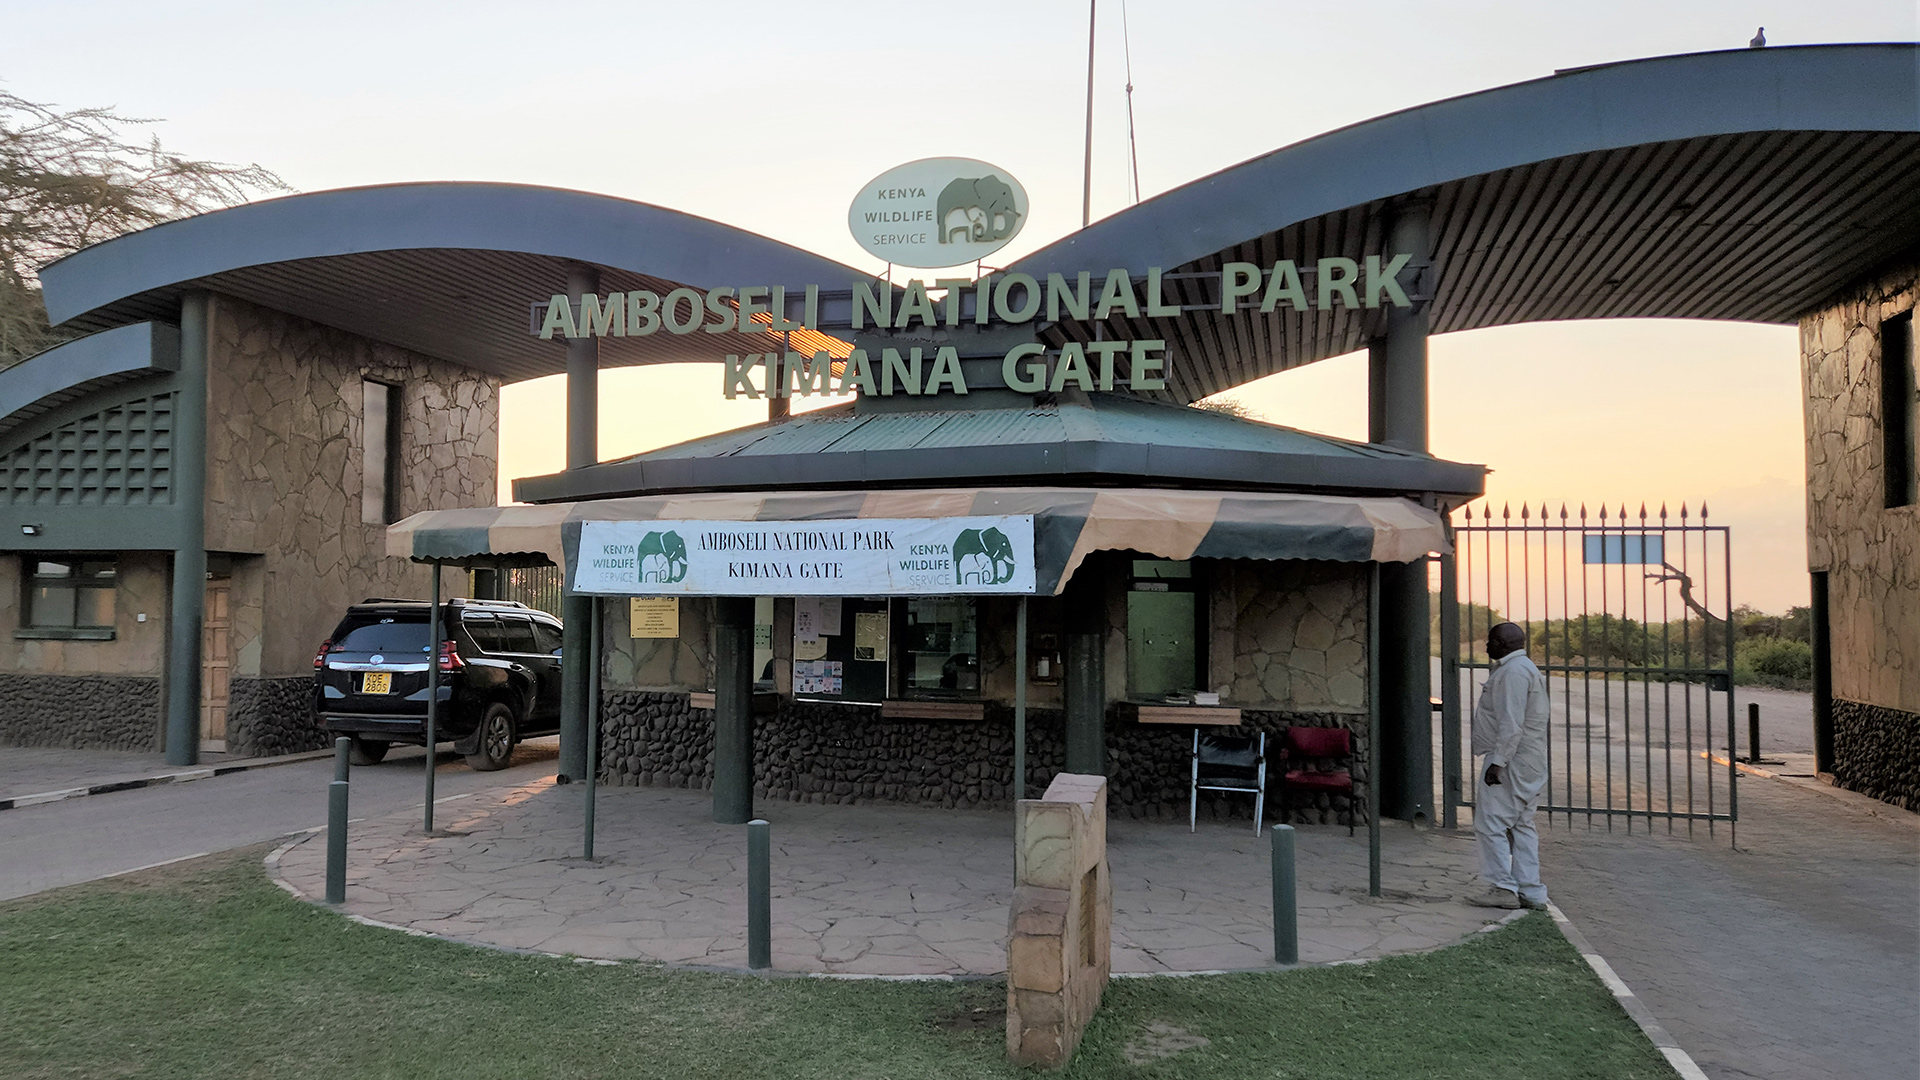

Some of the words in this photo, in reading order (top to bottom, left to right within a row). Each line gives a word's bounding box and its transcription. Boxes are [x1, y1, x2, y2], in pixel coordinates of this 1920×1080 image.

[878, 188, 926, 200] KENYA
[865, 210, 933, 223] WILDLIFE
[873, 233, 926, 245] SERVICE
[539, 284, 818, 338] AMBOSELI
[851, 267, 1180, 328] NATIONAL
[1221, 254, 1414, 314] PARK
[723, 346, 968, 400] KIMANA
[1002, 339, 1166, 393] GATE
[697, 532, 767, 551] AMBOSELI
[773, 531, 847, 550] NATIONAL
[853, 530, 895, 550] PARK
[603, 544, 635, 555] KENYA
[910, 544, 949, 555] KENYA
[592, 558, 634, 569] WILDLIFE
[899, 559, 950, 571] WILDLIFE
[728, 562, 794, 578] KIMANA
[799, 562, 843, 578] GATE
[599, 572, 634, 583] SERVICE
[909, 574, 950, 586] SERVICE
[366, 674, 382, 683] KDE
